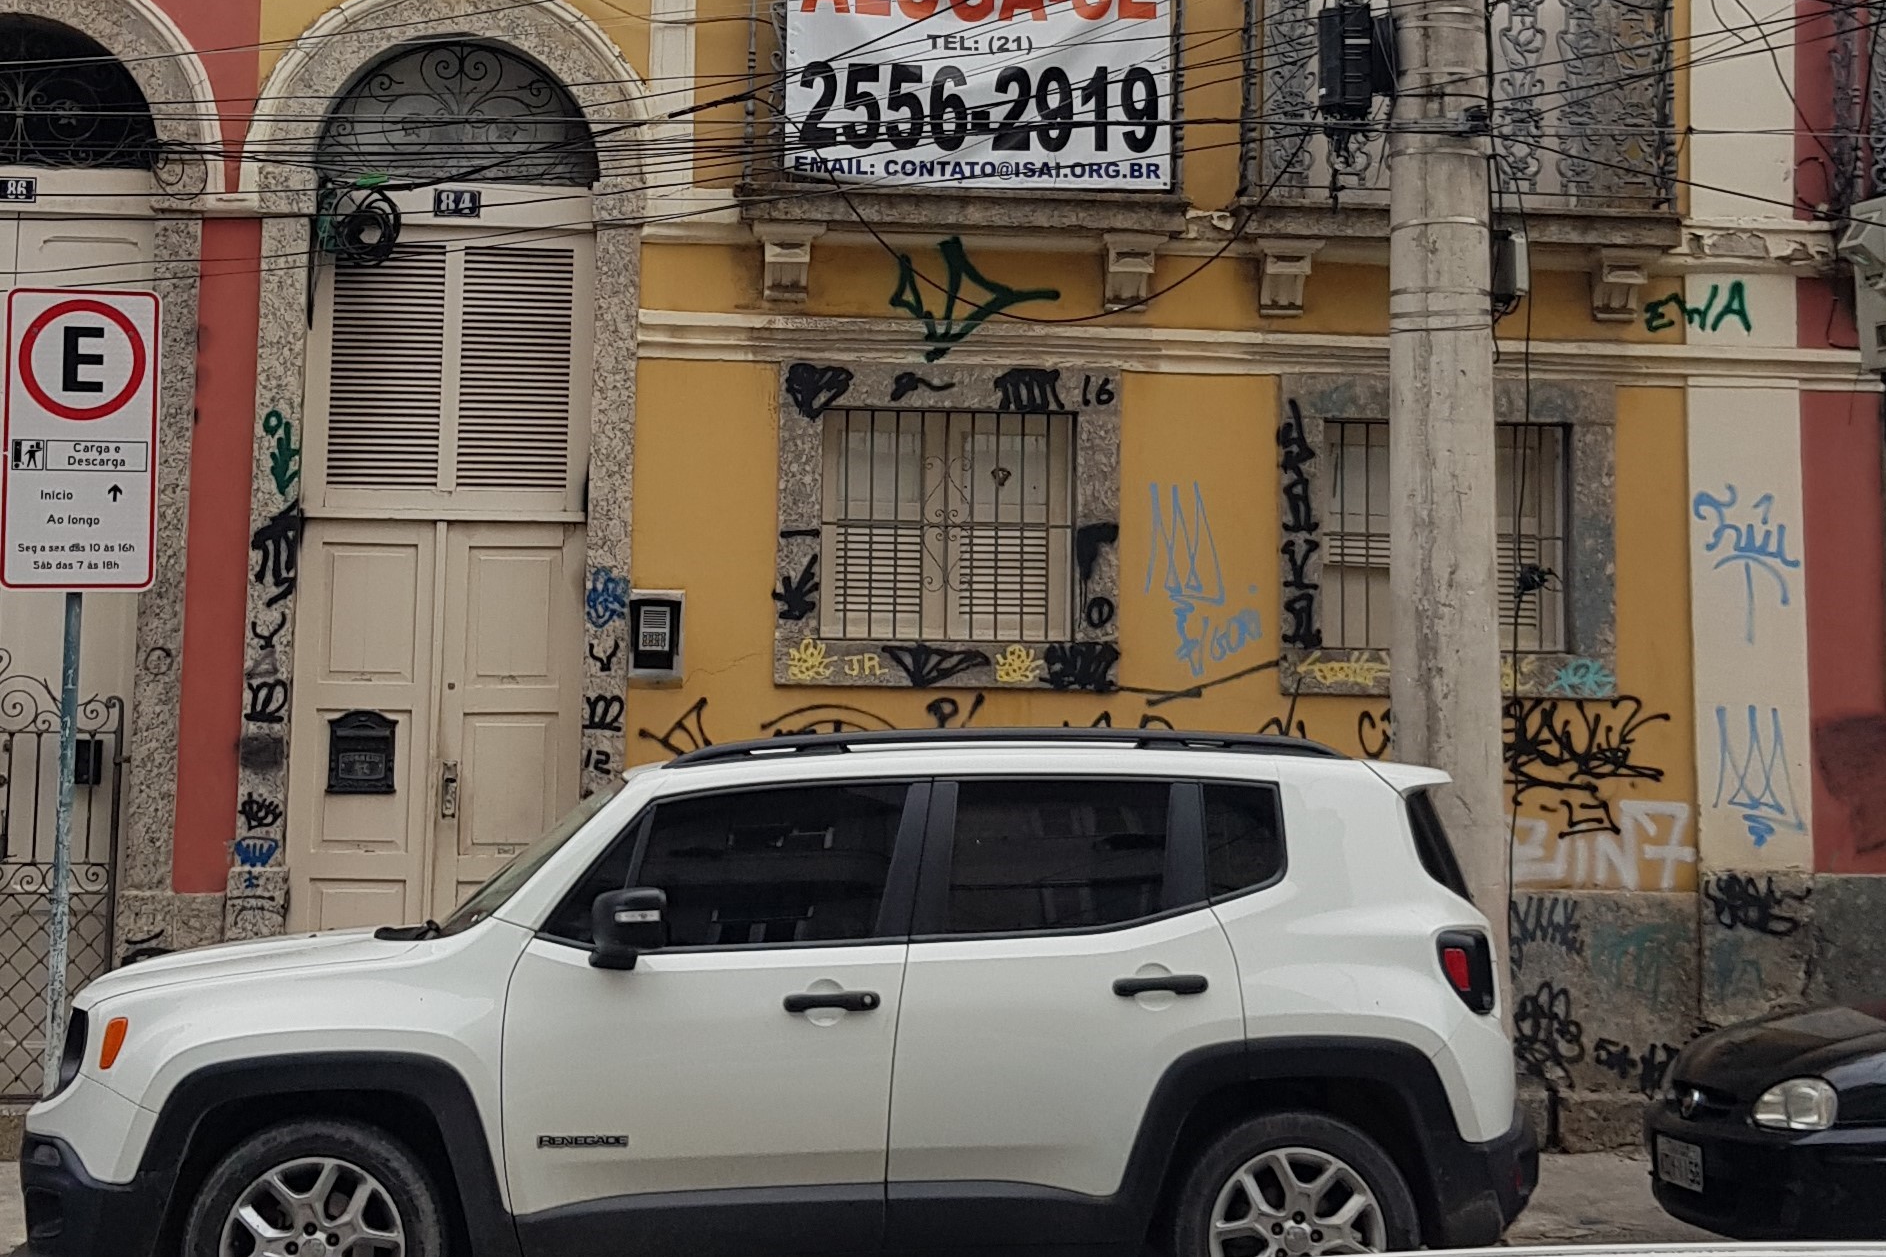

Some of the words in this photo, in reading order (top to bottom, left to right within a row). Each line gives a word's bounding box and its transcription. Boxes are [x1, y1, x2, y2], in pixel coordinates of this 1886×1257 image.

[927, 33, 979, 52] TEL:
[987, 35, 1033, 55] (21)
[799, 60, 1159, 153] 2556-2919
[794, 155, 875, 177] EMAIL:
[7, 180, 26, 199] 86
[440, 191, 473, 213] 84
[63, 326, 105, 393] E
[73, 443, 110, 455] Carga
[67, 456, 126, 469] Descarga
[40, 489, 73, 500] Início
[46, 514, 64, 524] Ao
[68, 515, 100, 527] longo
[18, 543, 37, 554] Seg
[89, 544, 100, 552] 10
[118, 544, 135, 552] 16h
[33, 561, 52, 570] Sáb
[55, 561, 73, 570] das
[76, 561, 84, 570] 7
[102, 561, 119, 570] 18h
[537, 1135, 629, 1148] RENEGADE
